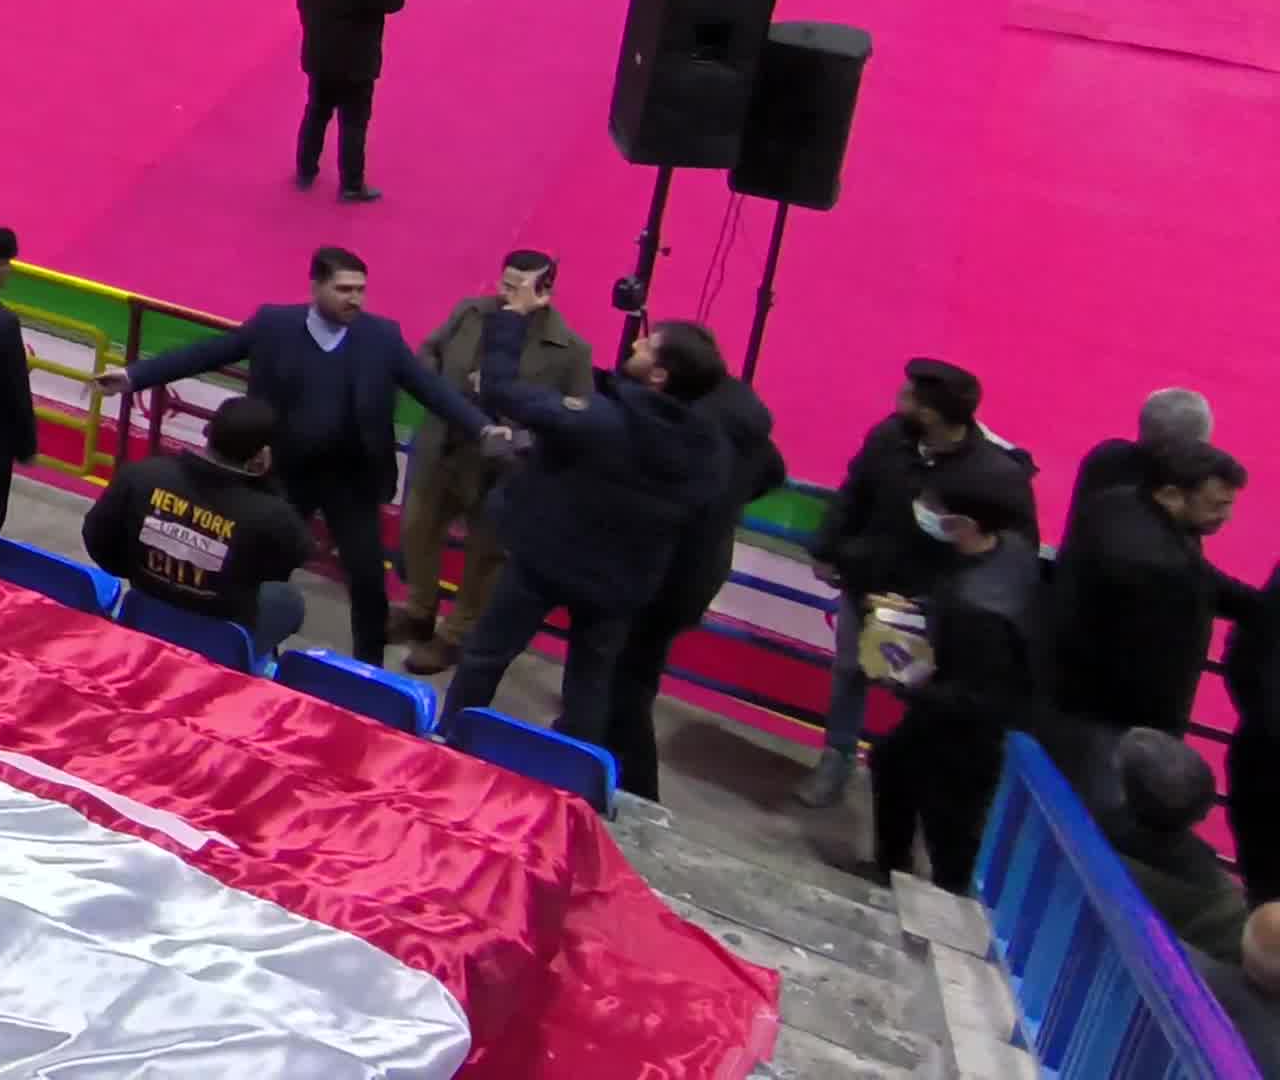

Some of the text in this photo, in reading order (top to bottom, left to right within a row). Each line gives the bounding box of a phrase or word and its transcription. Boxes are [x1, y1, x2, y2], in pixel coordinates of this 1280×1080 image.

[150, 488, 236, 539] NEW YORK
[158, 523, 210, 550] URBAN
[147, 551, 204, 586] CITY
